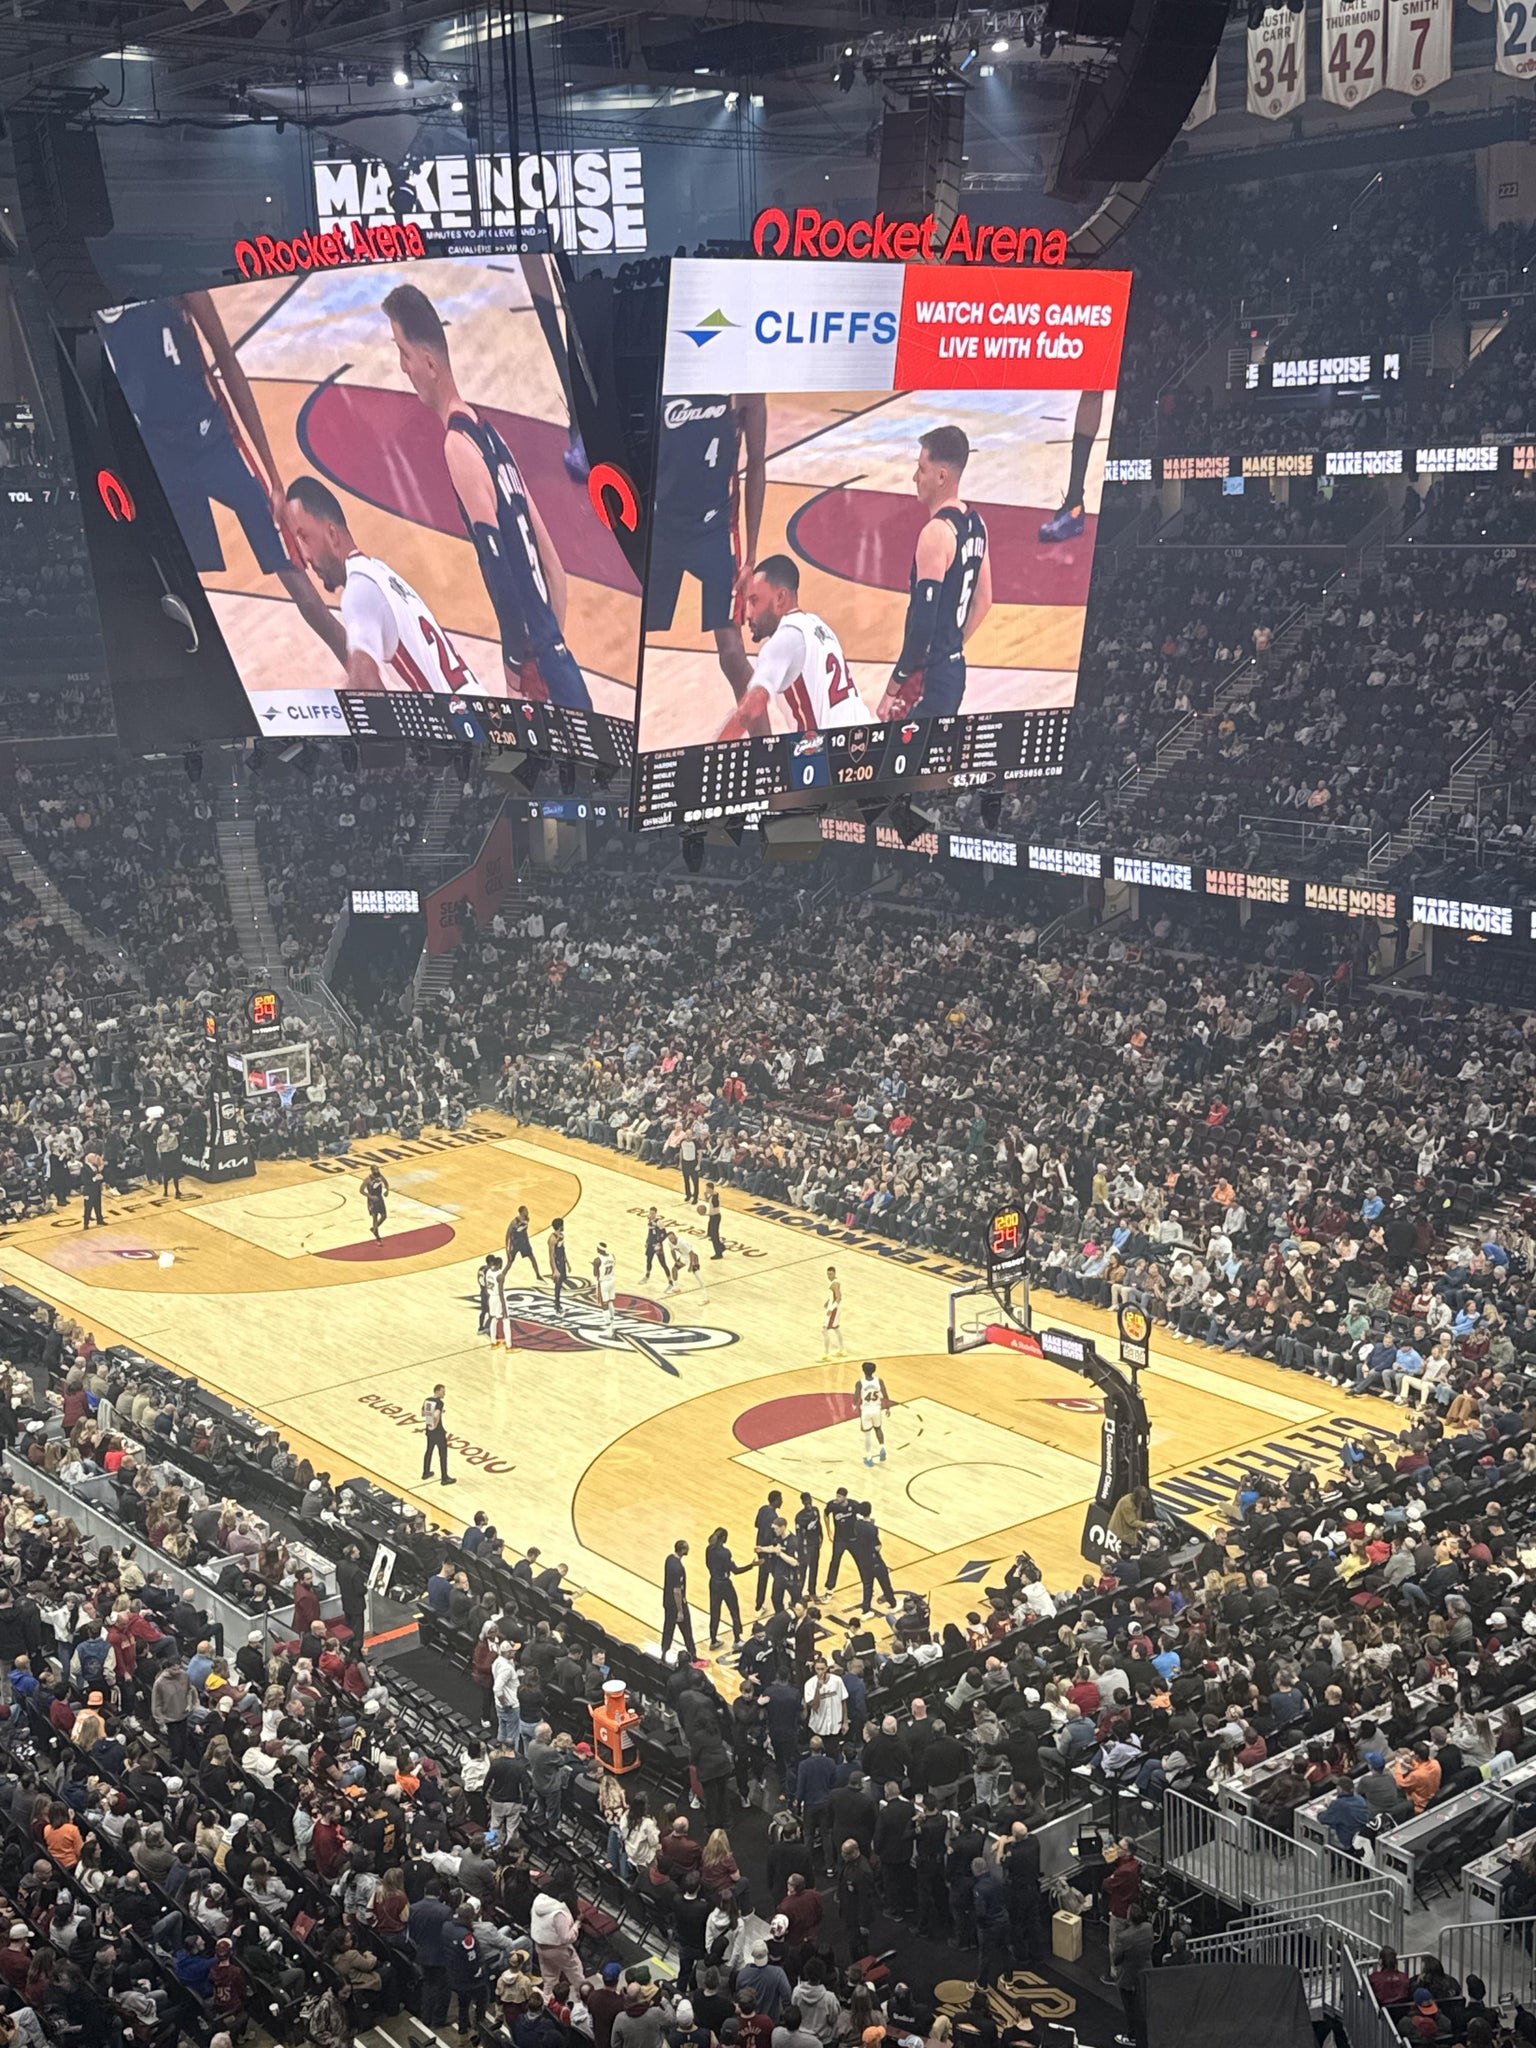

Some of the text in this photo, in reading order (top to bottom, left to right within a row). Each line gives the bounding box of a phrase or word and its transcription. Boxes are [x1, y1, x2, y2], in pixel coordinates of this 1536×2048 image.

[1402, 0, 1439, 15] SMITH
[1326, 9, 1380, 30] THURMOND
[1263, 27, 1291, 42] CARR
[1504, 2, 1536, 56] 2
[1410, 18, 1430, 70] 7
[1328, 29, 1376, 83] 42
[1254, 43, 1297, 97] 34
[314, 153, 645, 215] MAKE NOISE
[795, 208, 1067, 264] Rocket Arena
[256, 223, 350, 275] Rocket
[351, 221, 425, 262] Arena
[916, 302, 1112, 326] WATCH CAVS GAMES
[755, 310, 896, 345] CLIFFS
[162, 327, 180, 365] 4
[939, 332, 1083, 359] LIVE WITH fubo
[1273, 359, 1318, 377] MAKE
[1320, 356, 1371, 375] NOISE
[705, 438, 719, 467] 4
[1416, 447, 1498, 464] MAKE NOISE
[1163, 456, 1230, 469] MAKE NOISE
[1242, 455, 1313, 472] MAKE NOISE
[1326, 457, 1402, 475] MAKE NOISE
[1119, 467, 1152, 481] NOISE
[8, 492, 33, 502] TOL
[42, 491, 50, 502] 7
[956, 569, 973, 628] 5
[287, 705, 342, 721] CLIFFS
[472, 701, 483, 712] 1Q
[500, 703, 511, 714] 24
[464, 722, 474, 738] 0
[488, 730, 516, 746] 12:00
[527, 729, 538, 745] 0
[871, 731, 884, 743] 24
[830, 734, 845, 747] 1Q
[895, 755, 906, 774] 0
[803, 764, 814, 785] 0
[837, 765, 873, 783] 12:00
[953, 772, 987, 788] $5,710
[577, 804, 587, 818] 0
[593, 807, 606, 816] 1Q
[725, 801, 769, 816] RAFFLE
[643, 811, 672, 826] oswald
[836, 820, 866, 833] NOISE
[911, 832, 939, 850] OISE
[950, 843, 1017, 867] MAKE NOISE
[1029, 846, 1101, 870] MAKE NOISE
[1114, 864, 1192, 890] MAKE NOISE
[1206, 869, 1289, 891] MAKE NOISE
[1305, 883, 1396, 912] MAKE NOISE
[1413, 904, 1512, 936] MAKE NOISE
[254, 1005, 276, 1023] 24
[309, 1126, 506, 1175] CAVALIERS
[994, 1212, 1019, 1230] 12:00
[992, 1227, 1018, 1254] 24
[864, 1391, 879, 1402] 45
[1150, 1417, 1398, 1515] CLEVELAND
[600, 1727, 608, 1741] G
